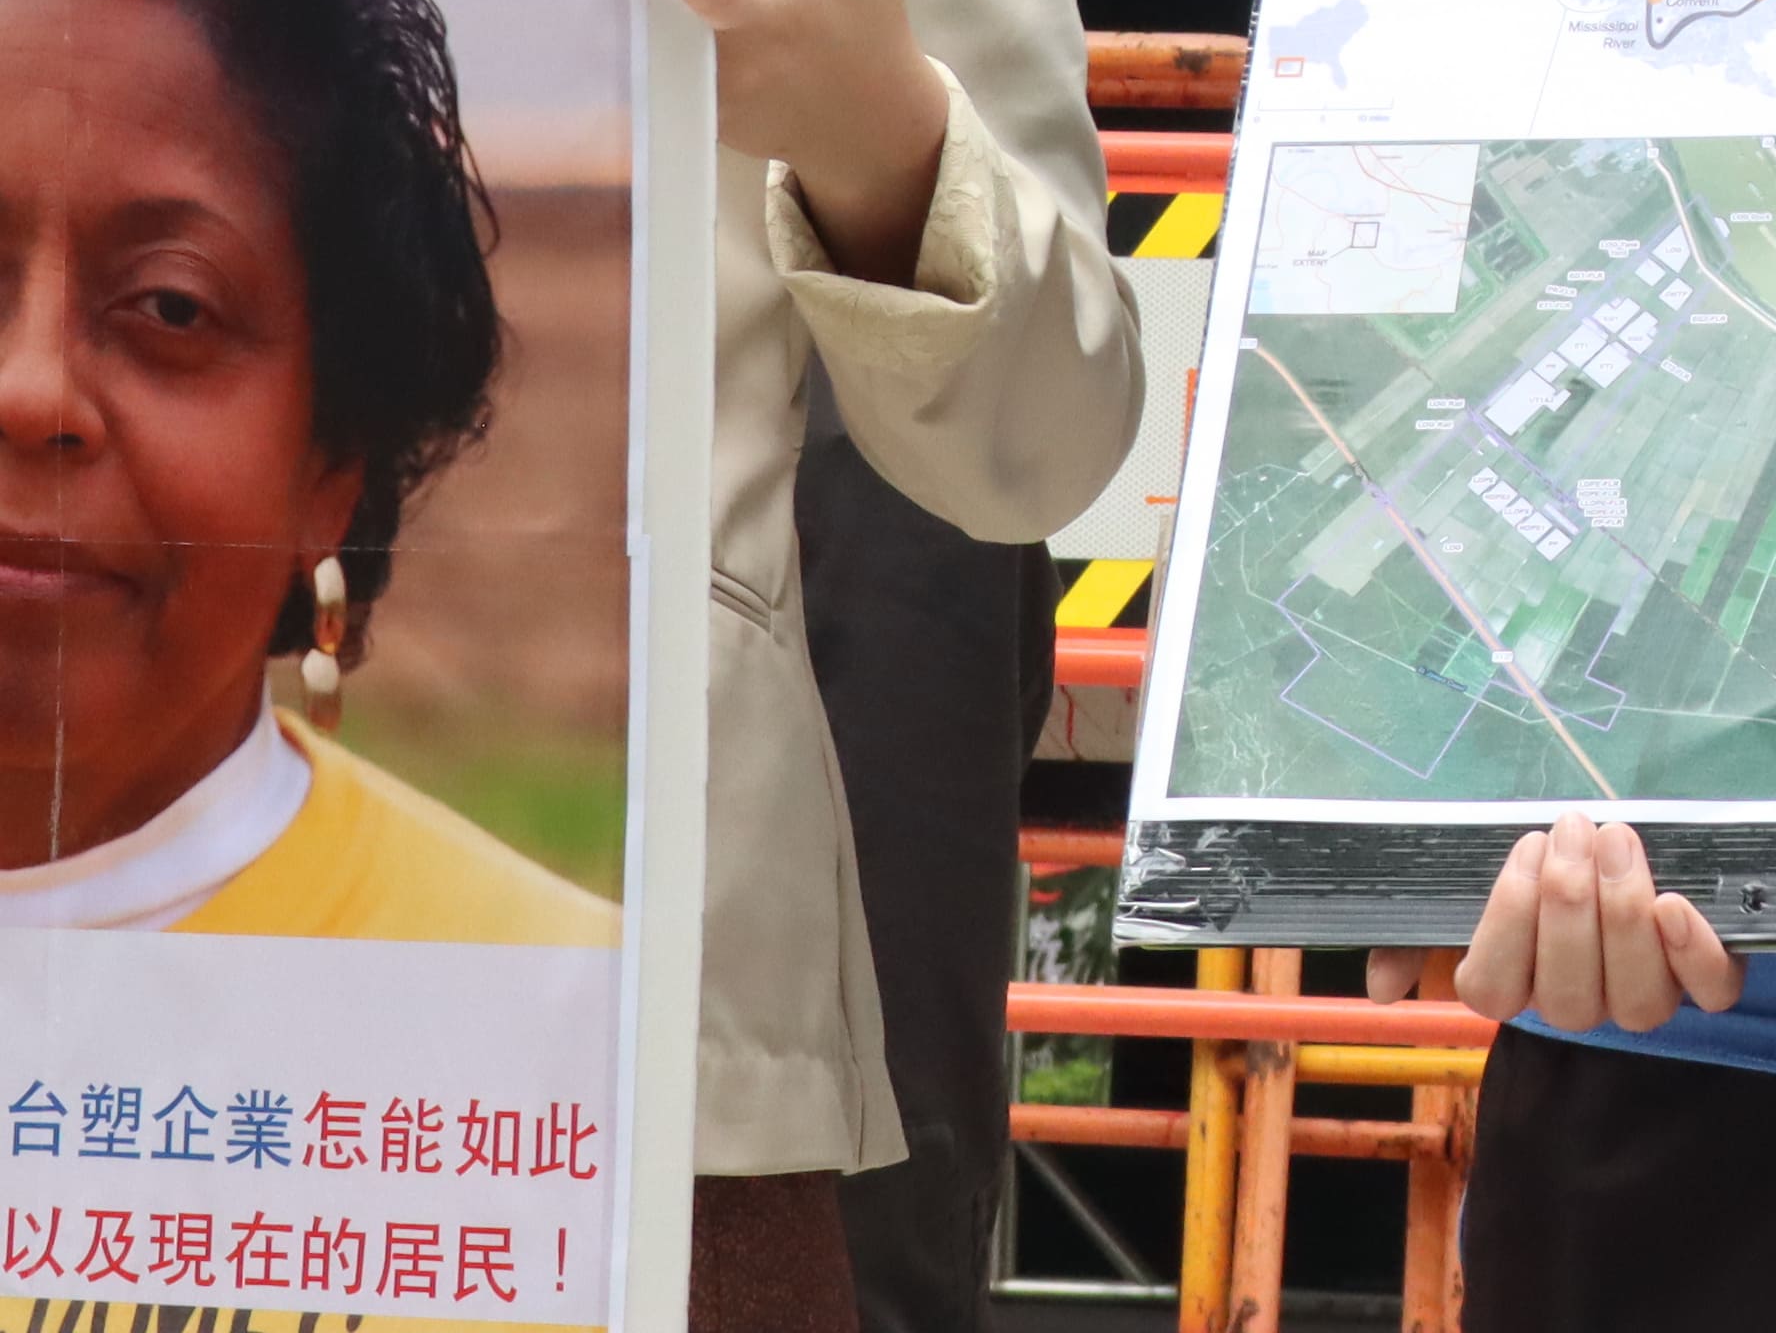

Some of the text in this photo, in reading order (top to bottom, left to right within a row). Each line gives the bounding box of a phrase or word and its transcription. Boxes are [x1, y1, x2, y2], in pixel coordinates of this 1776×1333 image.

[1602, 37, 1636, 50] River
[7, 1080, 599, 1180] 台塑企業怎能如此
